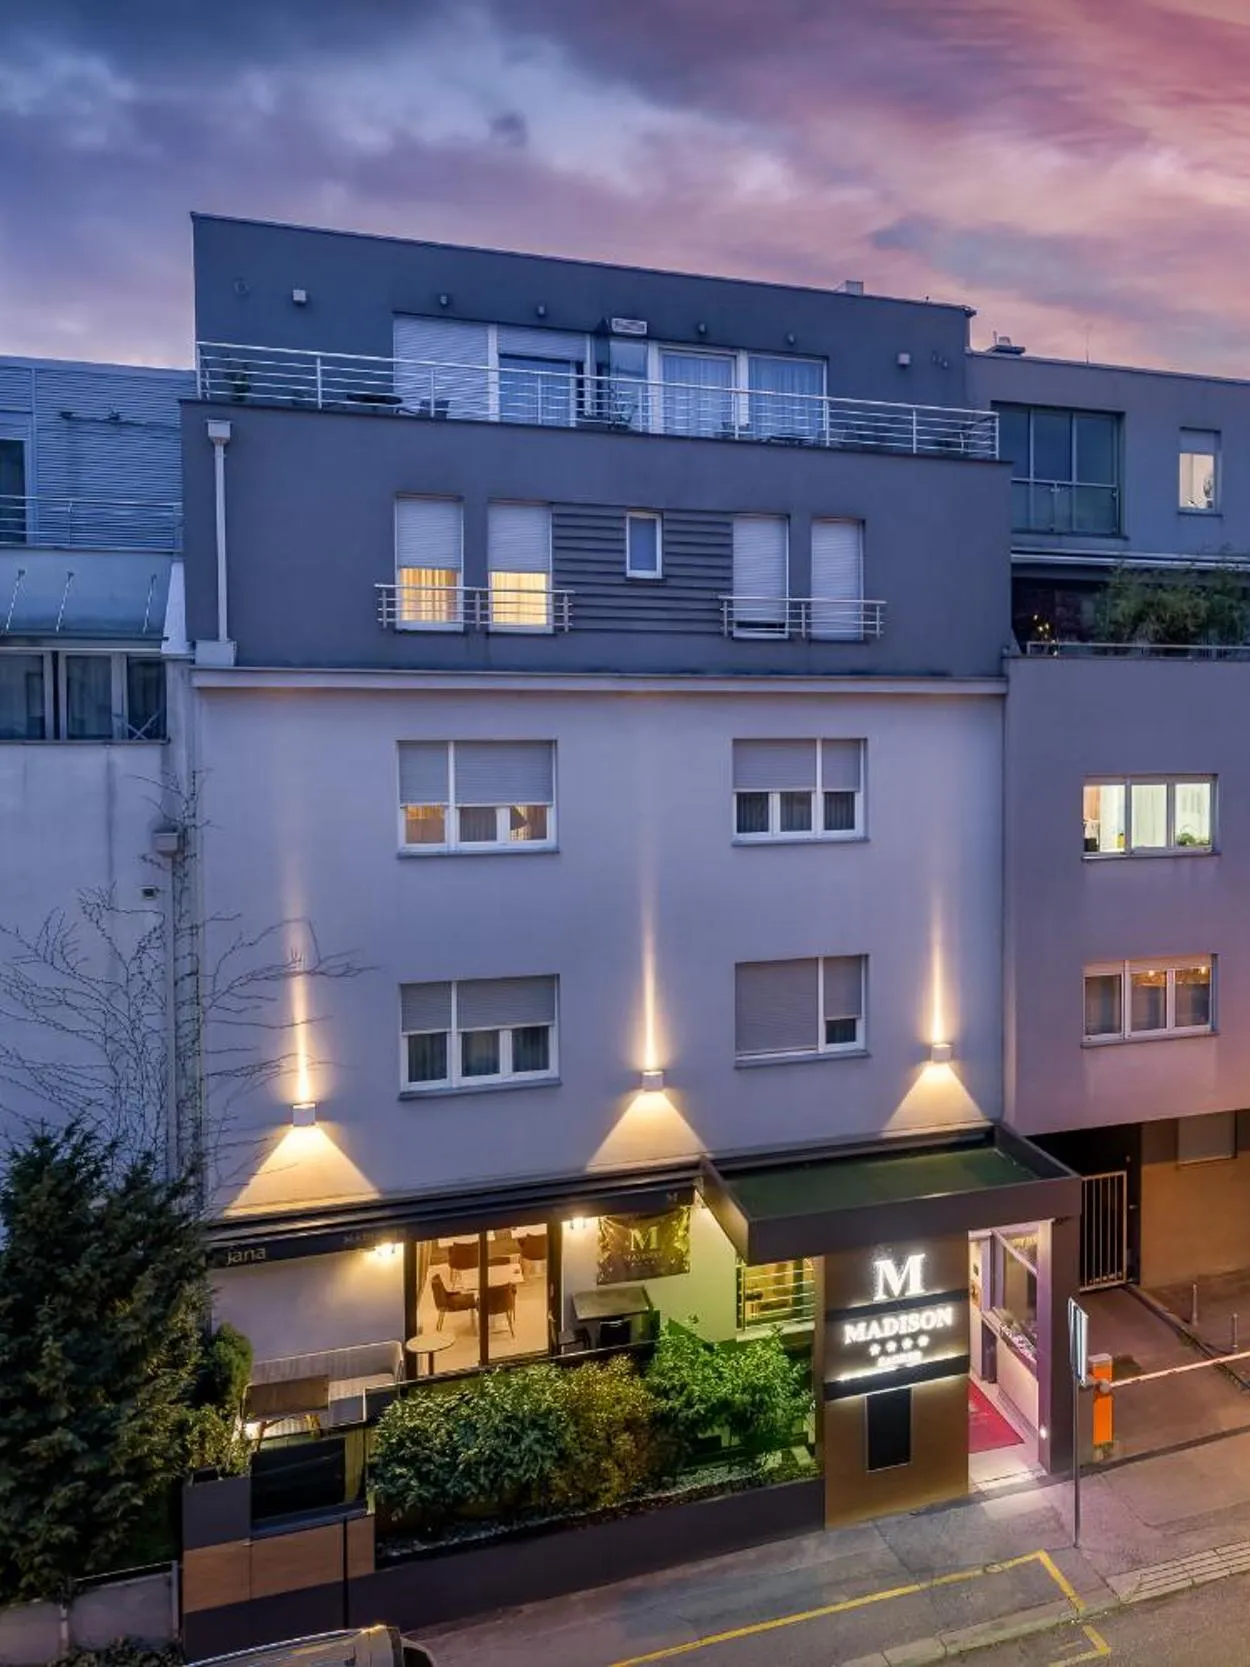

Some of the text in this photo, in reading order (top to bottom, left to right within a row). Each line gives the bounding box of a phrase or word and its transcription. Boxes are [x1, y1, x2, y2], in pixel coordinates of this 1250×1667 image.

[629, 1226, 658, 1251] M
[872, 1253, 926, 1302] M
[843, 1306, 953, 1345] MADISON
